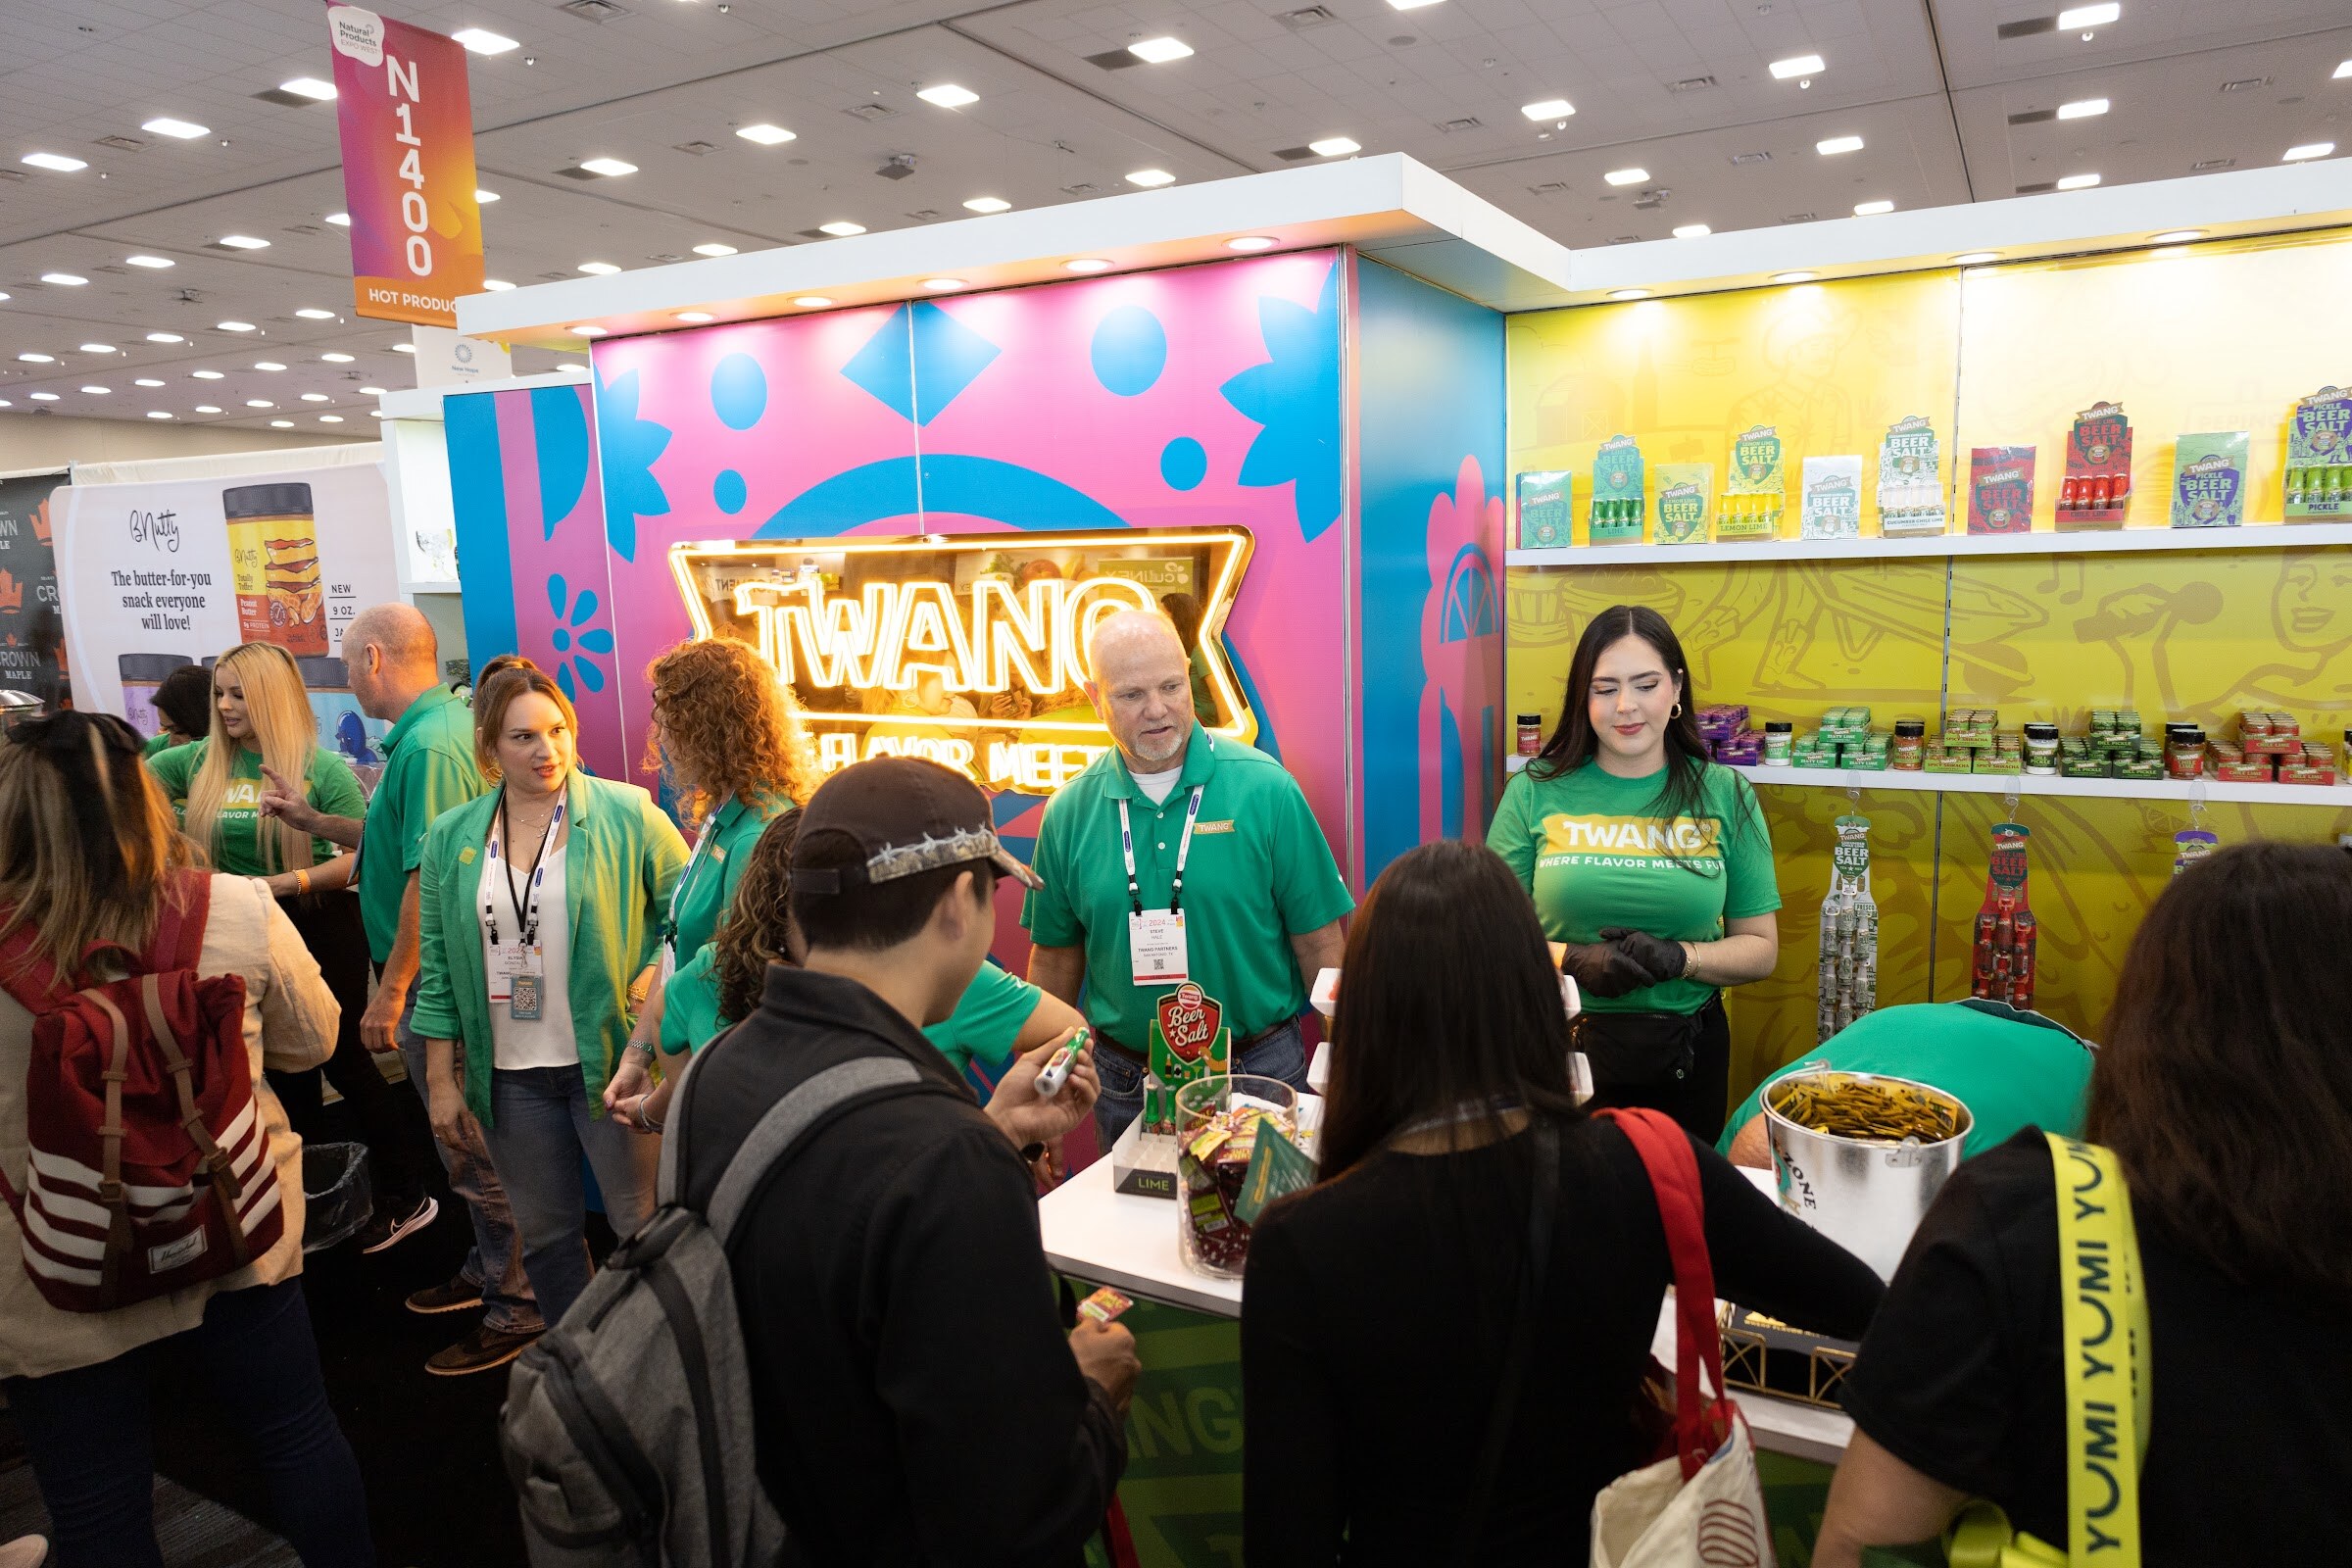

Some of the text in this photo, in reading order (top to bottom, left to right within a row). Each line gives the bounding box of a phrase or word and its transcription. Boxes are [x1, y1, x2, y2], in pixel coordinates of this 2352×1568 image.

[339, 21, 369, 36] Natural
[340, 30, 377, 47] Products
[341, 38, 359, 50] EXPO
[386, 54, 432, 276] N1400
[368, 288, 398, 304] HOT
[2308, 390, 2348, 405] TWANG
[2082, 406, 2119, 420] TWANG
[2302, 409, 2350, 421] BEER
[1893, 419, 1926, 432] TWANG
[2079, 424, 2122, 436] BEER
[2305, 420, 2345, 432] SALT
[1741, 429, 1773, 441] TWANG
[2081, 435, 2118, 446] SALT
[1604, 438, 1633, 450] TWANG
[1890, 437, 1929, 448] BEER
[1740, 446, 1775, 456] BEER
[1893, 447, 1928, 459] SALT
[1602, 455, 1635, 465] BEER
[1741, 456, 1774, 466] SALT
[2189, 460, 2230, 473] TWANG
[1984, 471, 2020, 483] TWANG
[1816, 479, 1847, 491] TWANG
[2186, 479, 2231, 490] BEER
[1532, 492, 1561, 505] TWANG
[1665, 486, 1695, 499] TWANG
[1981, 489, 2021, 500] BEER
[2187, 490, 2229, 501] SALT
[1663, 503, 1698, 513] BEER
[1812, 497, 1849, 507] BEER
[1531, 509, 1562, 518] BEER
[1665, 513, 1696, 522] SALT
[1815, 507, 1848, 516] SALT
[111, 568, 212, 589] The butter-for-you
[331, 584, 351, 593] NEW
[122, 592, 206, 612] snack everyone
[333, 607, 338, 615] 9
[141, 613, 191, 630] will love!
[0, 651, 40, 666] ROWN
[5, 670, 32, 679] MAPLE
[1199, 823, 1230, 832] TWANG
[1835, 847, 1869, 857] BEER
[2180, 850, 2211, 858] TWANG
[1539, 856, 1580, 868] WHERE
[1584, 856, 1646, 868] FLAVOR
[1652, 858, 1703, 869] MEETS
[1836, 856, 1867, 865] SALT
[1991, 857, 2028, 867] BEER
[1992, 866, 2024, 876] SALT
[1167, 1006, 1205, 1028] Beer
[1174, 1024, 1209, 1047] Salt
[1138, 1178, 1169, 1192] LIME
[1783, 1152, 1817, 1210] ZONE
[2076, 1239, 2115, 1381] YUMI
[1126, 1386, 1245, 1458] NG
[2084, 1399, 2122, 1554] YUMI
